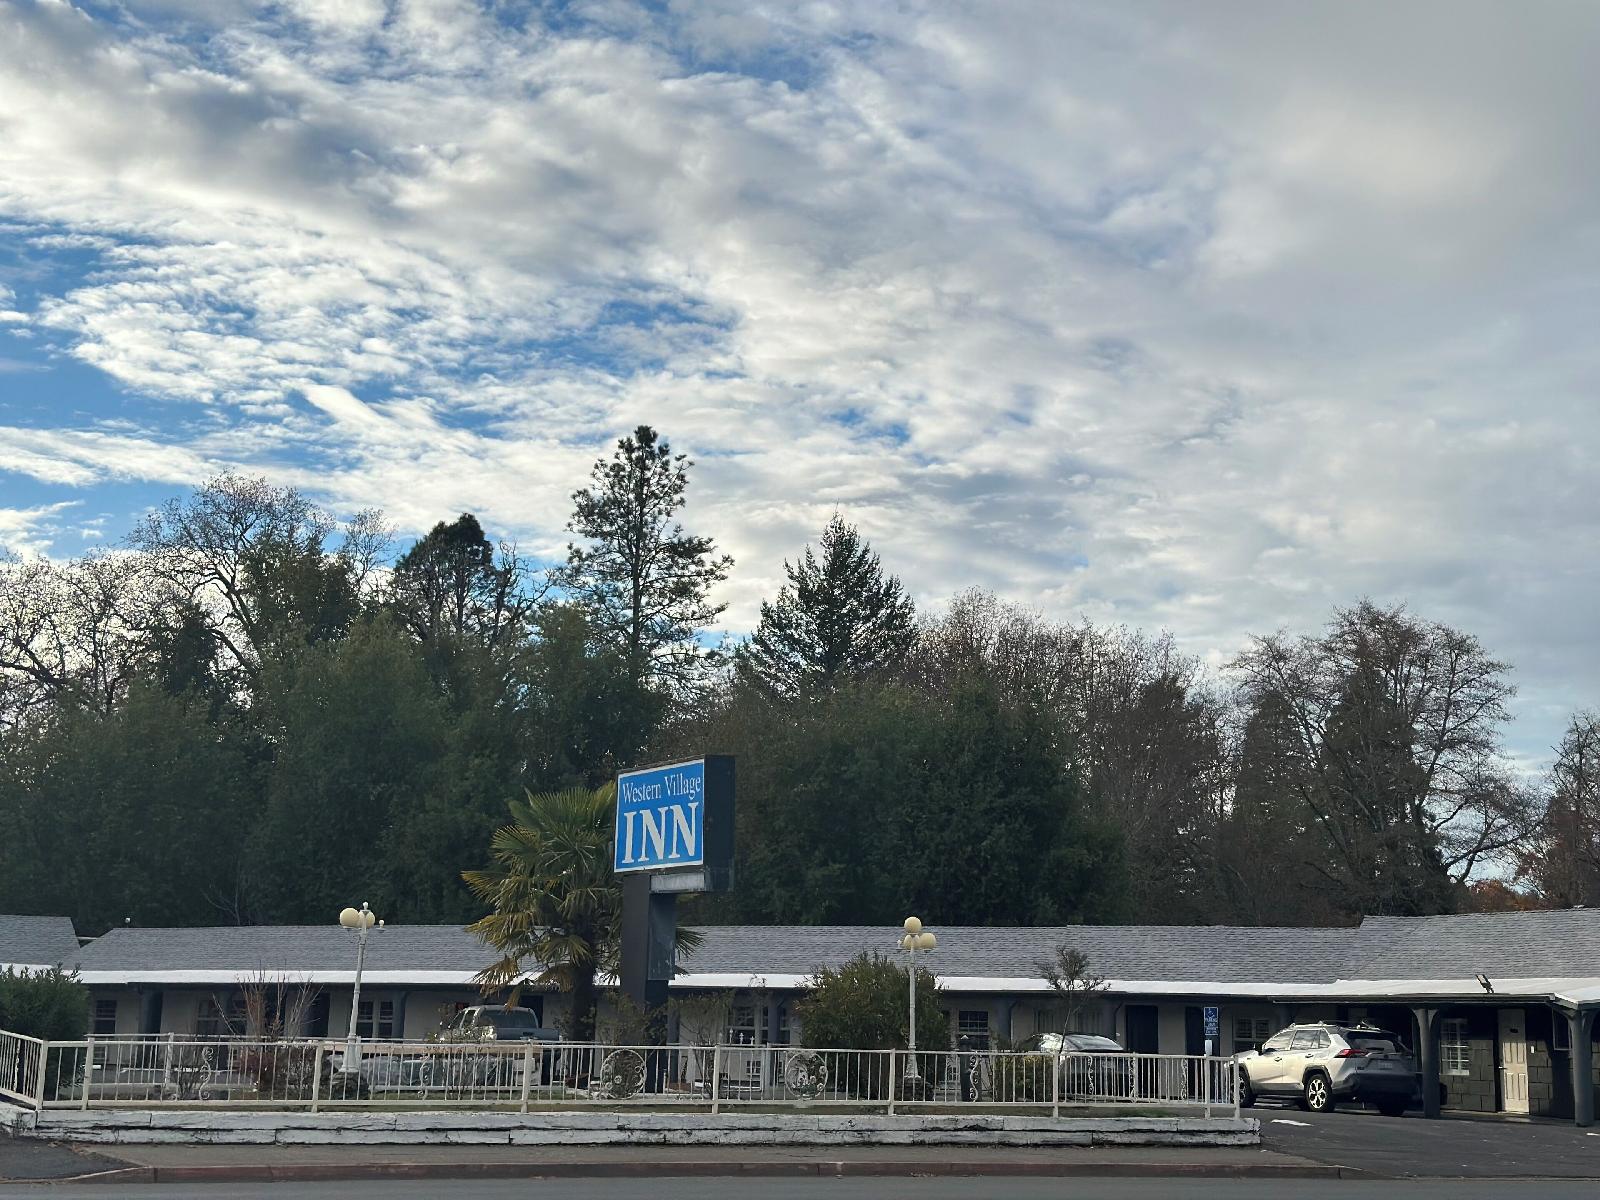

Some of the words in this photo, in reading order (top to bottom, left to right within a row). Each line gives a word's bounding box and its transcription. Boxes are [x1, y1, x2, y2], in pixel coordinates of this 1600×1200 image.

[622, 782, 661, 804] Western
[664, 773, 701, 800] Village
[622, 802, 699, 863] INN
